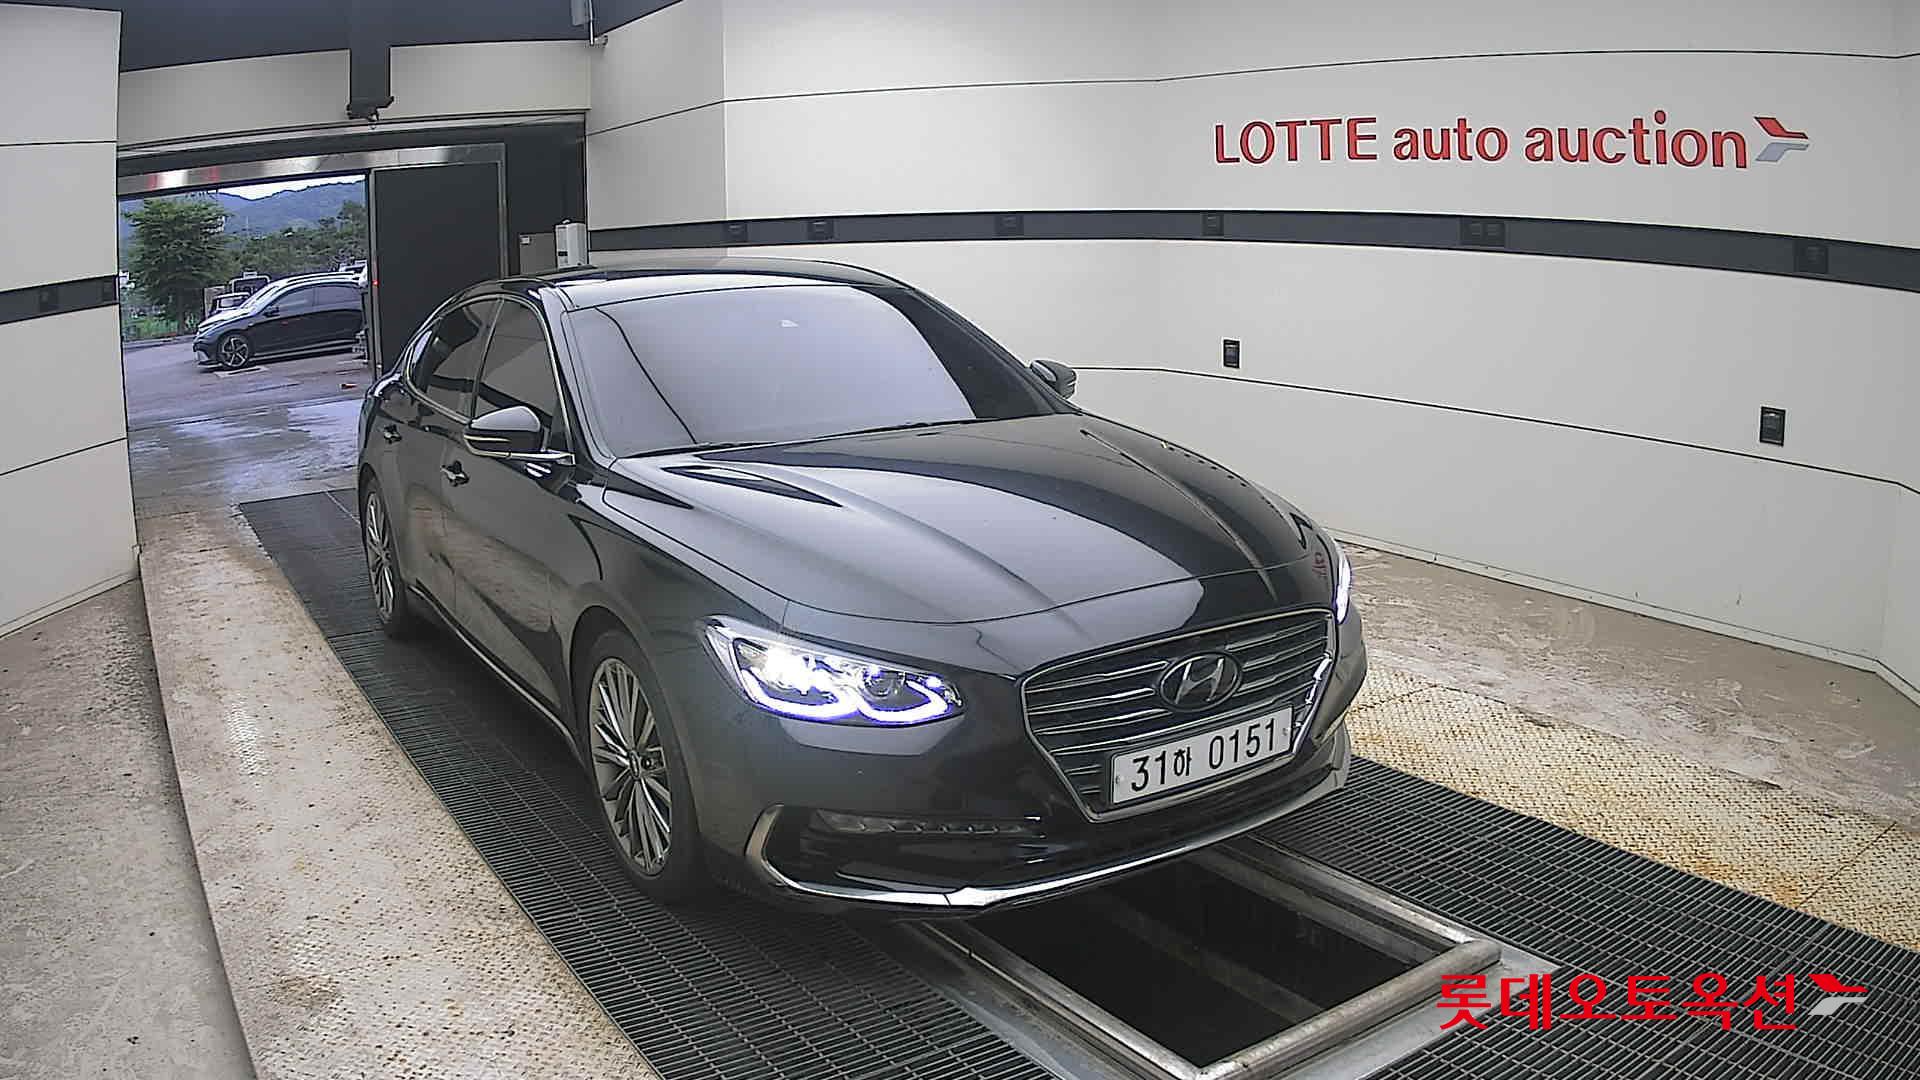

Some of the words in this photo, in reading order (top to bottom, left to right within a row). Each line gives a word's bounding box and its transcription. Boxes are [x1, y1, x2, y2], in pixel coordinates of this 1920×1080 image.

[1215, 116, 1377, 164] LOTTE
[1393, 117, 1508, 162] auto
[1524, 110, 1748, 168] auction
[1131, 746, 1192, 793] 31하
[1208, 717, 1276, 770] 0151
